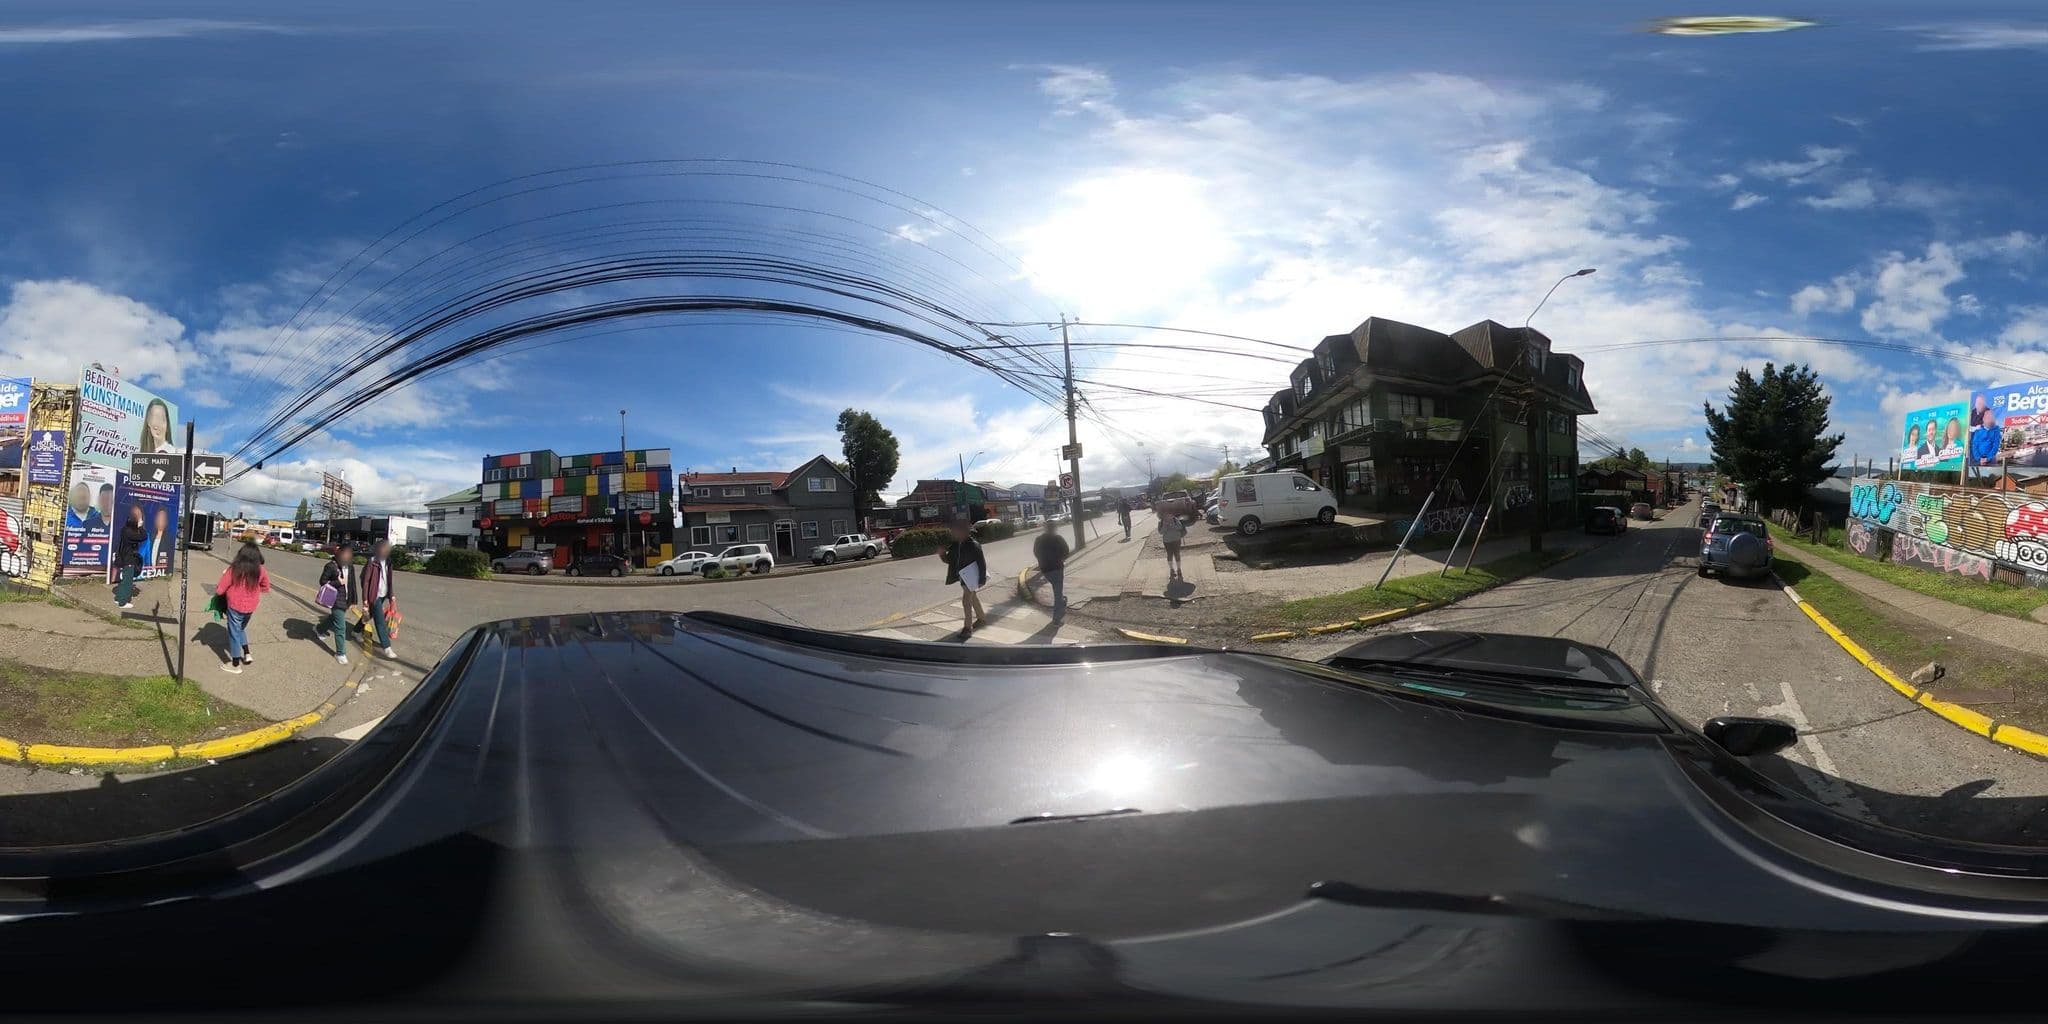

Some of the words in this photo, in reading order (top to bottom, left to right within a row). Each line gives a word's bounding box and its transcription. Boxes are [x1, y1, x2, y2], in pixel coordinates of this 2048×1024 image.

[85, 369, 120, 393] BEATRIZ
[83, 383, 145, 418] KUNSTMANN
[96, 426, 120, 440] invito
[82, 435, 128, 459] Futuro
[117, 441, 139, 453] crear
[133, 457, 148, 465] JOSE
